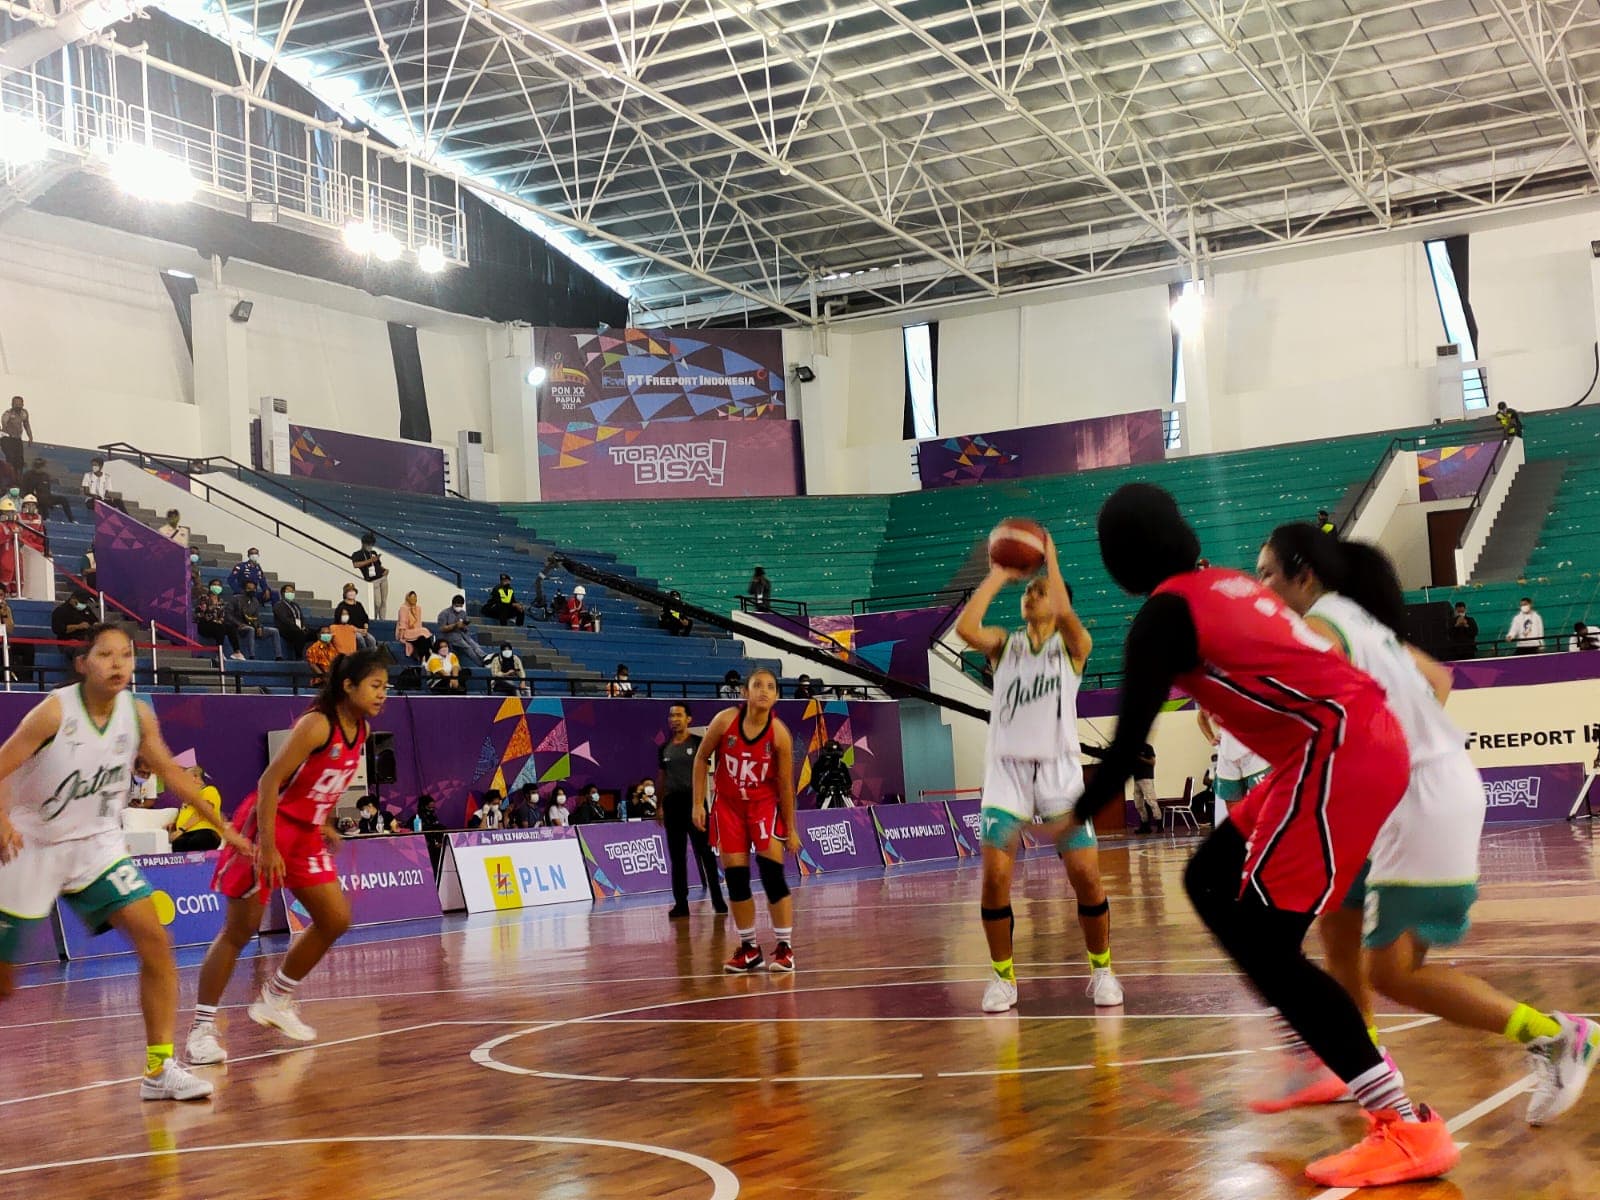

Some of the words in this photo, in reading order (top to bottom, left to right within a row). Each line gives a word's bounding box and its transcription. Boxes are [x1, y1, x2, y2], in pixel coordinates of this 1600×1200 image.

[626, 374, 645, 387] PT
[645, 374, 698, 387] FREEPORT
[699, 374, 756, 387] INDONESIA
[551, 386, 570, 395] PON
[573, 386, 585, 395] XX
[555, 396, 582, 404] PAPUA
[608, 442, 712, 465] TORANG
[1464, 729, 1576, 750] FREEPORT
[725, 753, 769, 783] DKI
[1483, 779, 1530, 794] RANG
[807, 823, 848, 841] TORANG
[885, 828, 901, 840] PON
[900, 827, 912, 839] XX
[911, 825, 934, 838] PAPUA
[604, 838, 656, 859] TORANG
[143, 856, 170, 866] PAPUA
[106, 863, 146, 896] 12
[337, 875, 349, 891] X
[350, 871, 398, 891] PAPUA
[398, 869, 424, 887] 2021
[518, 864, 567, 894] PLN
